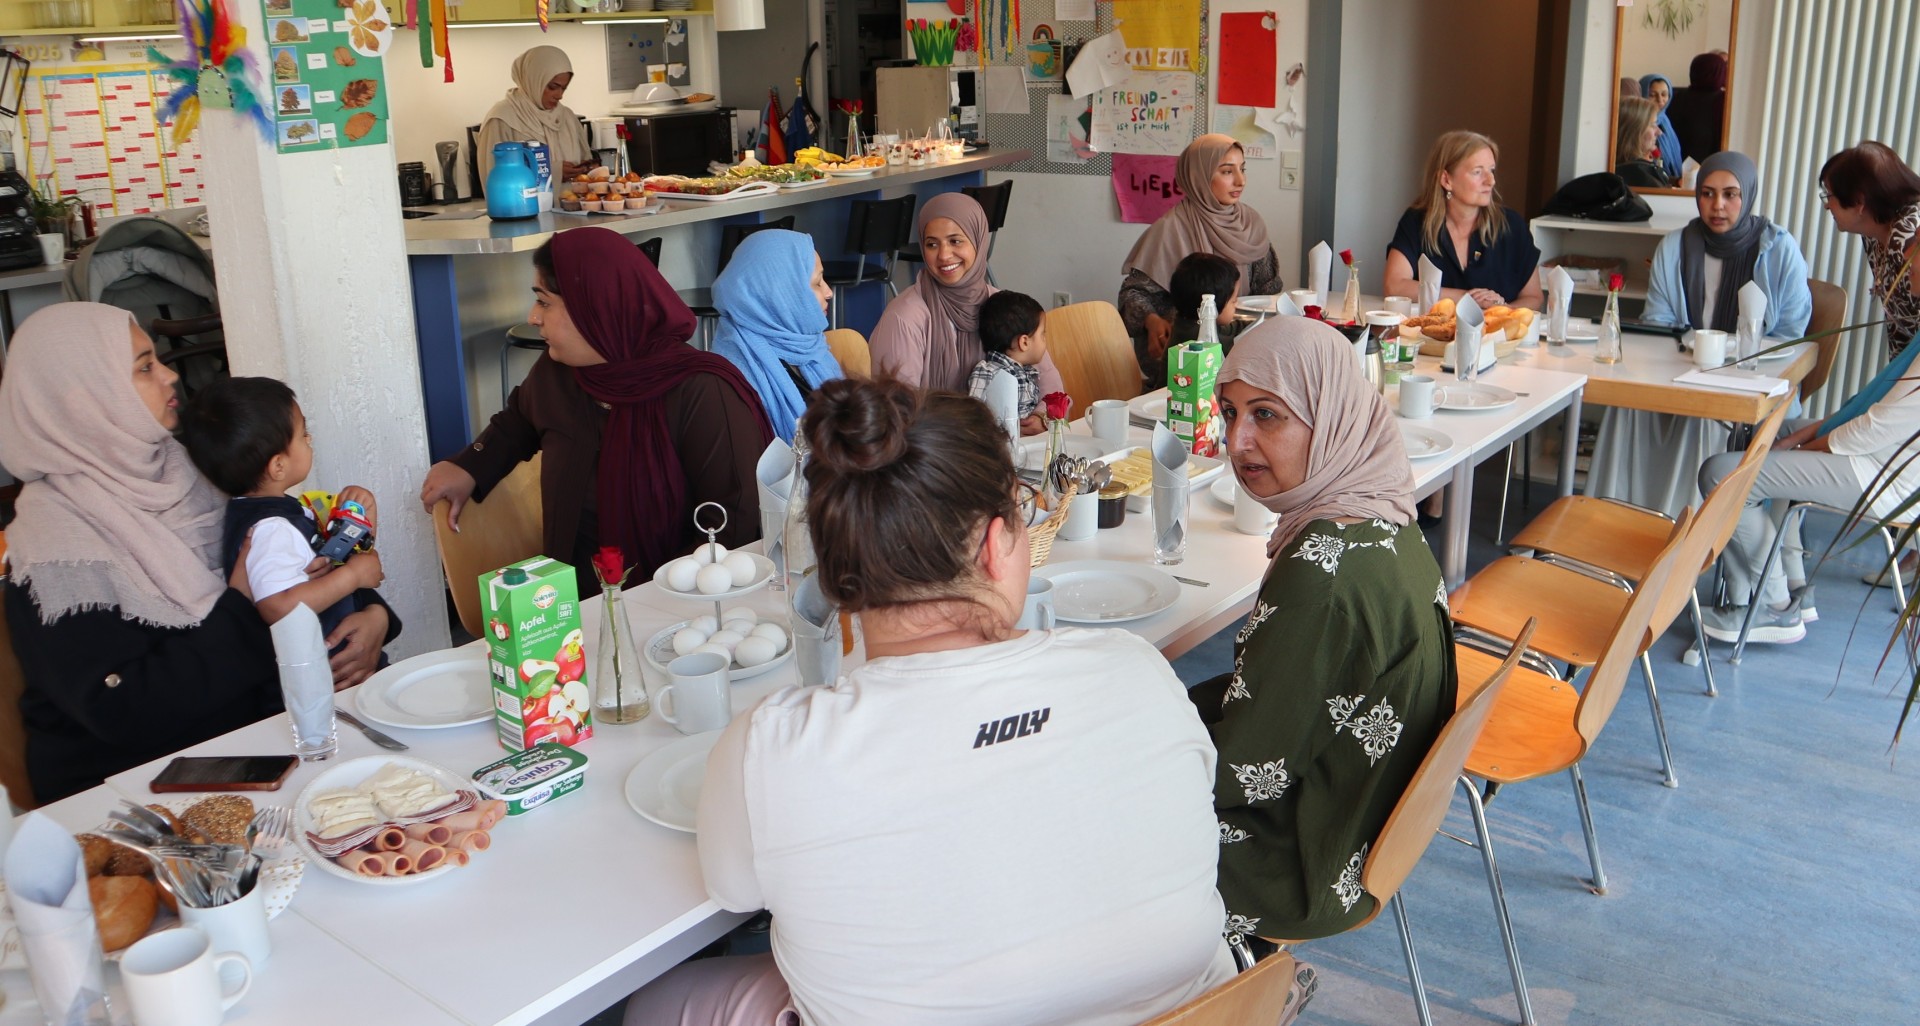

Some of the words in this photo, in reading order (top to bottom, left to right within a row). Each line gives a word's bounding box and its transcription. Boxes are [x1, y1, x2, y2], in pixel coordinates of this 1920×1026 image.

[1131, 106, 1180, 122] SCHAFT
[1116, 122, 1129, 131] ist
[1151, 121, 1170, 132] mich
[1130, 173, 1183, 199] LIEBE
[519, 613, 546, 632] Apfel
[559, 610, 573, 618] SAFT
[973, 707, 1050, 749] HOLY
[508, 759, 568, 785] Exquisa
[553, 780, 563, 790] Der
[523, 789, 551, 806] Exquisa
